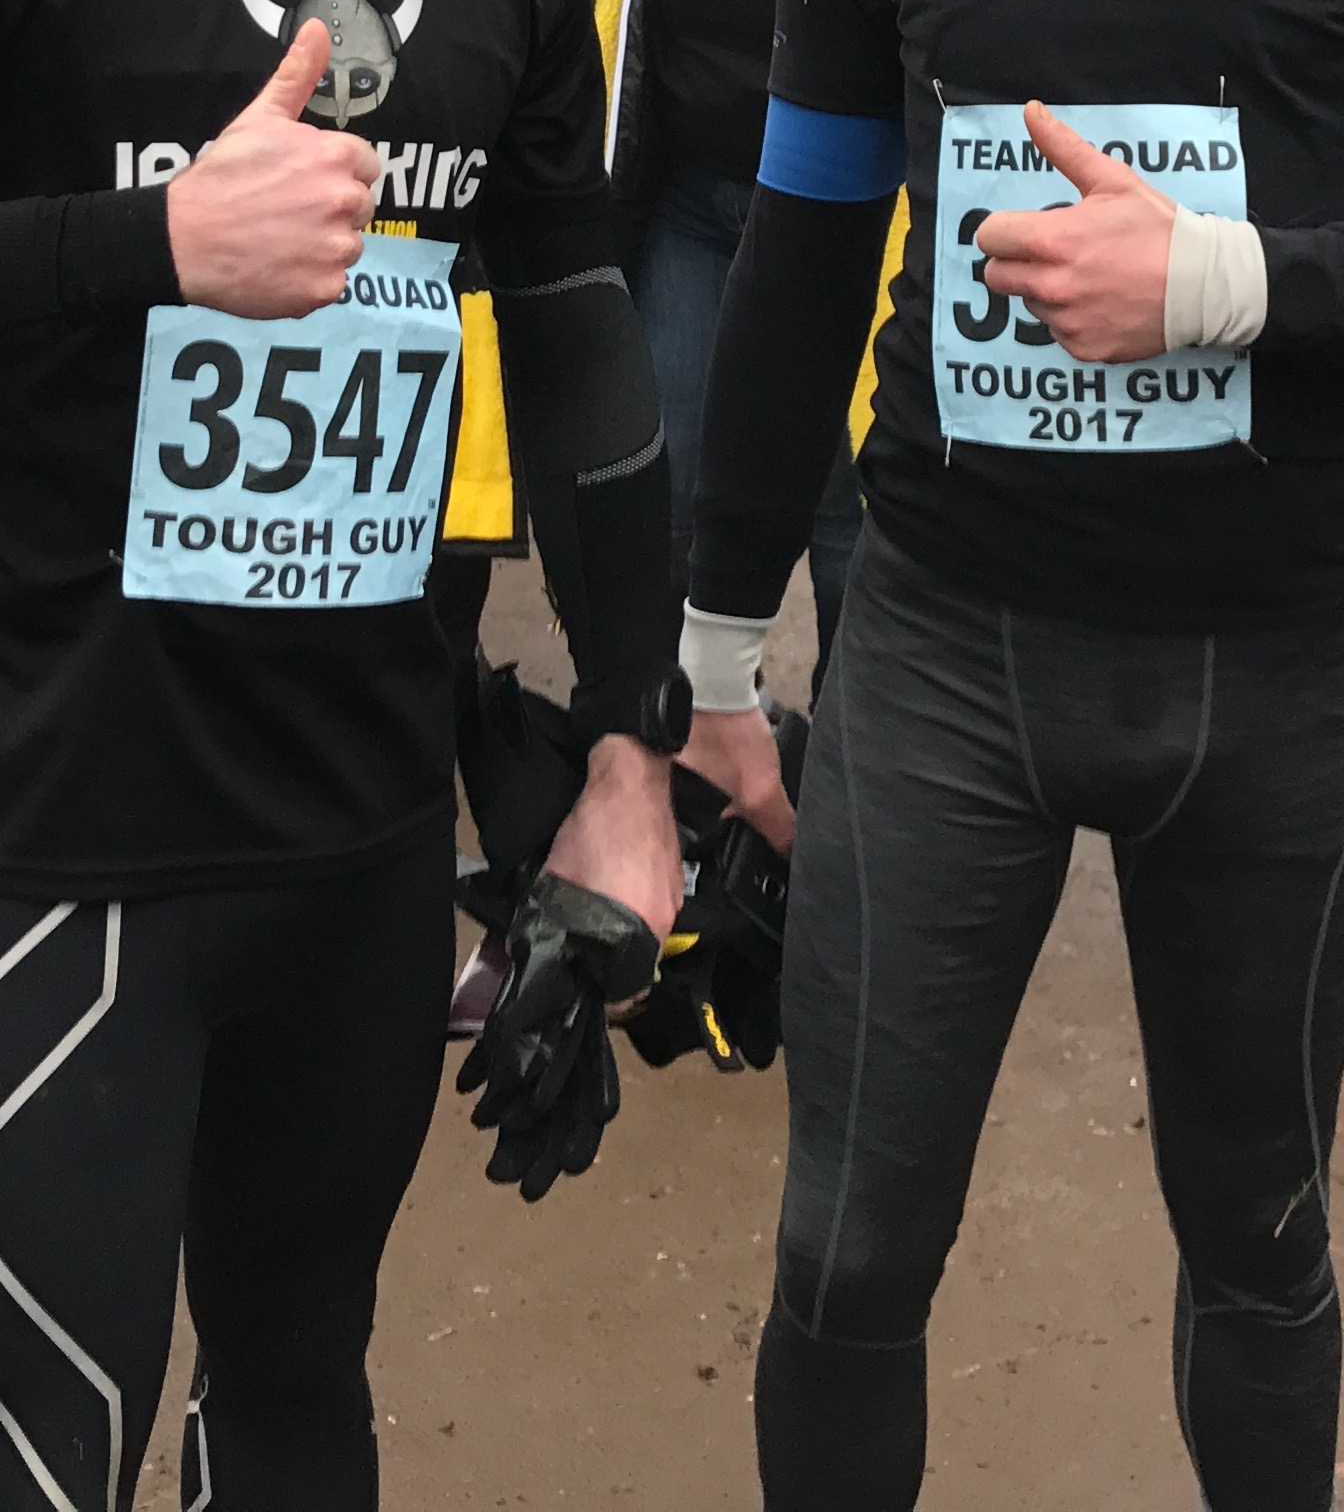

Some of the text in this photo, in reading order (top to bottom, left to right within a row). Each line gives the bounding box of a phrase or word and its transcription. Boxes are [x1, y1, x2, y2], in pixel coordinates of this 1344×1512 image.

[952, 138, 1238, 173] TEAM QUAD
[946, 360, 1236, 403] TOUGH GUY
[158, 339, 450, 494] 3547
[1028, 406, 1144, 443] 2017
[143, 511, 428, 556] TOUGH GUY
[244, 562, 362, 599] 2017
